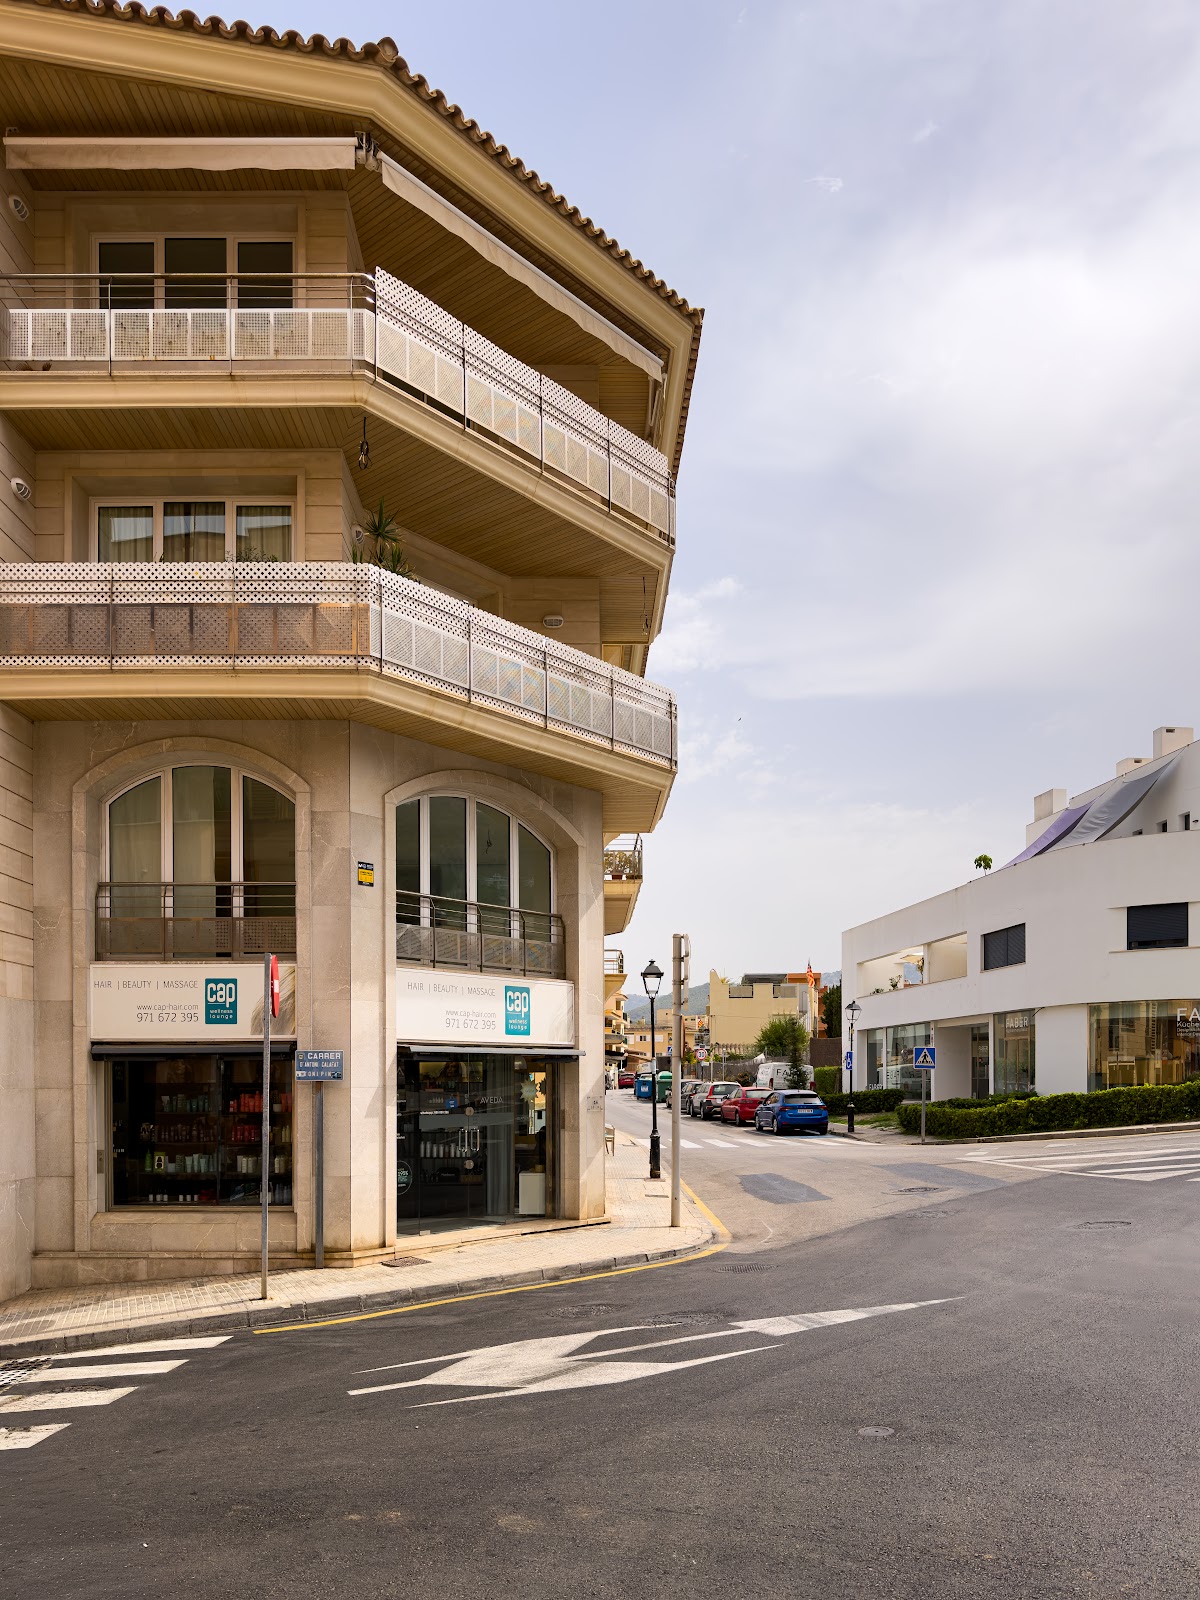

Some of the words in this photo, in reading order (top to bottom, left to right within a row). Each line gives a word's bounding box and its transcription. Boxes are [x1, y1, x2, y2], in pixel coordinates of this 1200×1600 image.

[93, 981, 113, 989] HAIR
[122, 981, 152, 989] BEAUTY
[163, 980, 198, 989] MASSAGE
[407, 982, 424, 991] HAIR
[433, 984, 458, 994] BEAUTY
[467, 987, 496, 997] MASSAGE
[207, 983, 235, 1008] cap
[136, 1003, 199, 1012] www.cap-hair.com
[506, 990, 529, 1018] cap
[136, 1013, 154, 1023] 971
[158, 1013, 177, 1023] 672
[180, 1013, 199, 1023] 395
[445, 1009, 496, 1019] www.cap-hair.com
[445, 1017, 460, 1028] 971
[463, 1019, 479, 1029] 672
[481, 1020, 496, 1030] 395
[1005, 1016, 1029, 1028] FABER
[307, 1052, 341, 1060] CARRER
[479, 1096, 504, 1104] AVEDA
